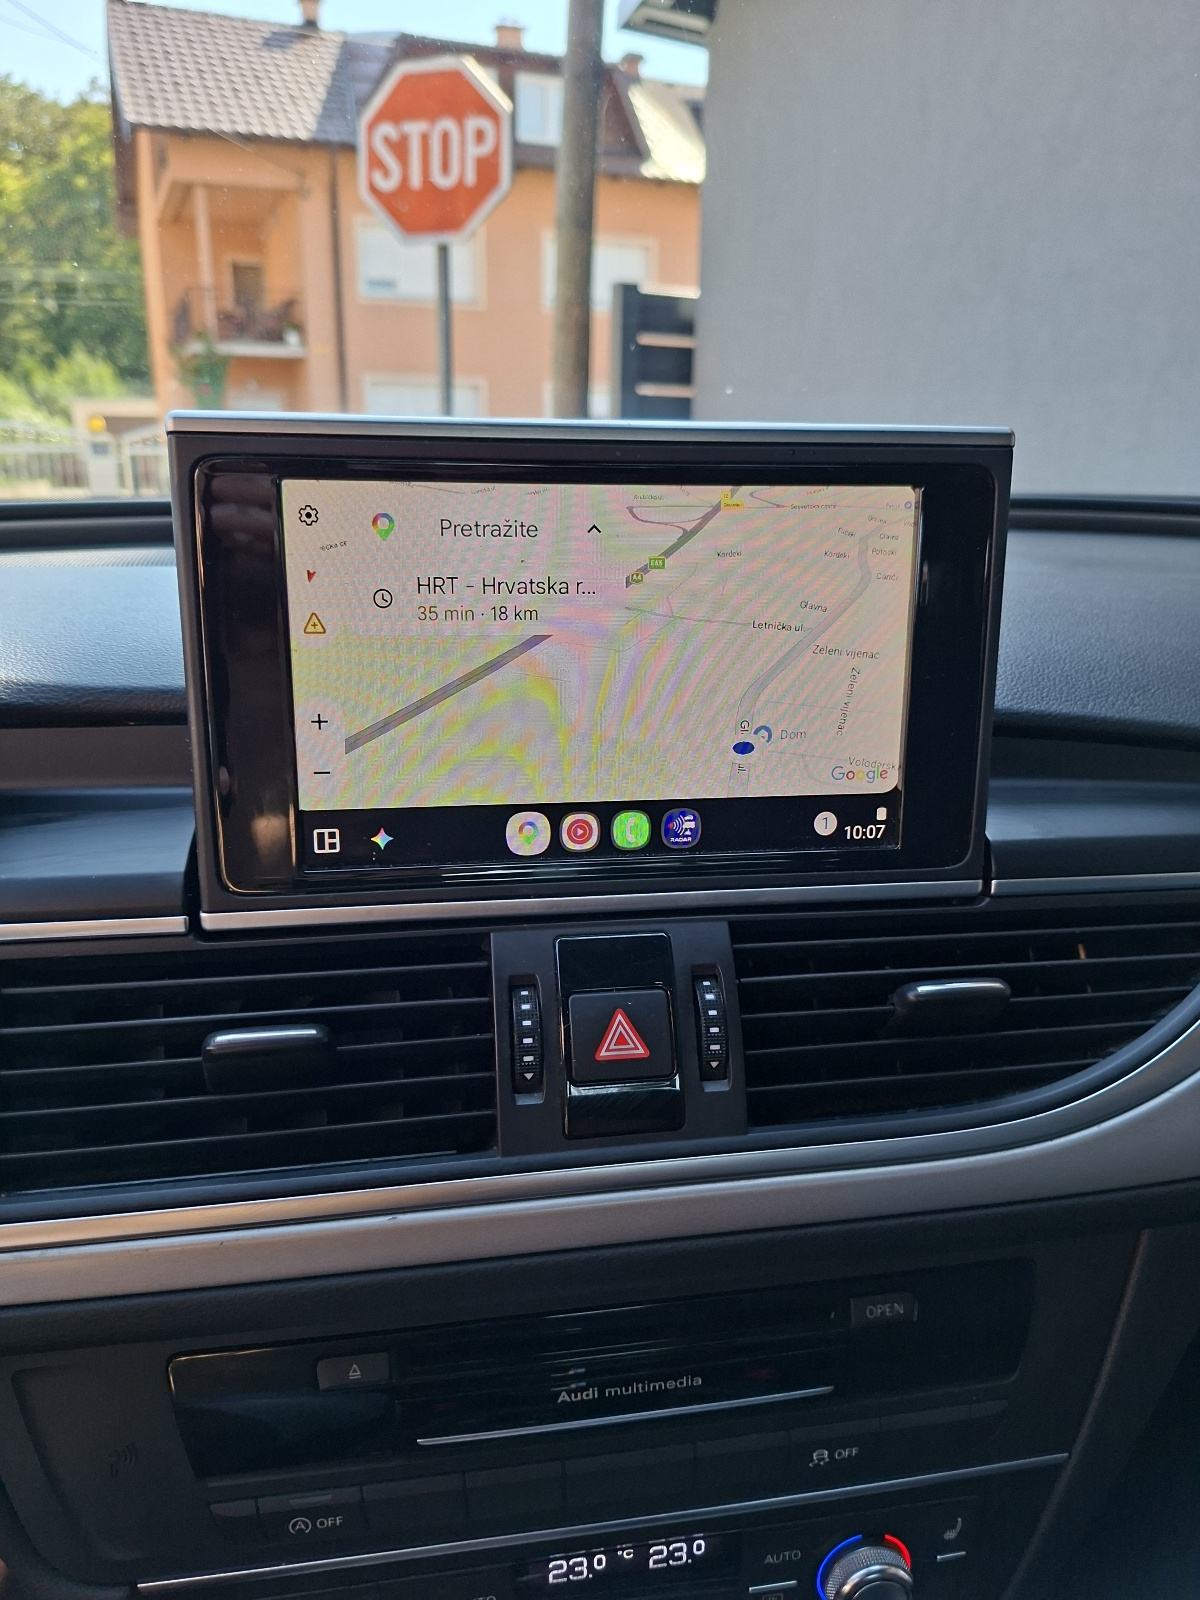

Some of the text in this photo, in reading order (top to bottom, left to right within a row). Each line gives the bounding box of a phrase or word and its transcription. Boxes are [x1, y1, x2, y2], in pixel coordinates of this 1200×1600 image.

[370, 116, 498, 193] STOP
[439, 519, 539, 538] Pretražite
[417, 576, 459, 595] HRT
[482, 576, 569, 595] Hrvatska
[417, 605, 438, 621] 35
[444, 605, 475, 621] min
[490, 605, 508, 621] 18
[513, 604, 539, 621] km
[799, 600, 828, 613] Glavna
[752, 620, 806, 633] Letnička ul.
[812, 644, 880, 661] Zeleni vijenac
[780, 729, 807, 740] Dom
[831, 765, 889, 784] Google
[844, 824, 886, 840] 10:07
[865, 1302, 904, 1319] OPEN
[556, 1374, 702, 1403] Audi multimedia
[834, 1447, 859, 1460] OFF
[316, 1515, 344, 1529] OFF
[548, 1553, 607, 1584] 23.0
[648, 1539, 706, 1569] 23.0
[763, 1550, 802, 1565] AUTO
